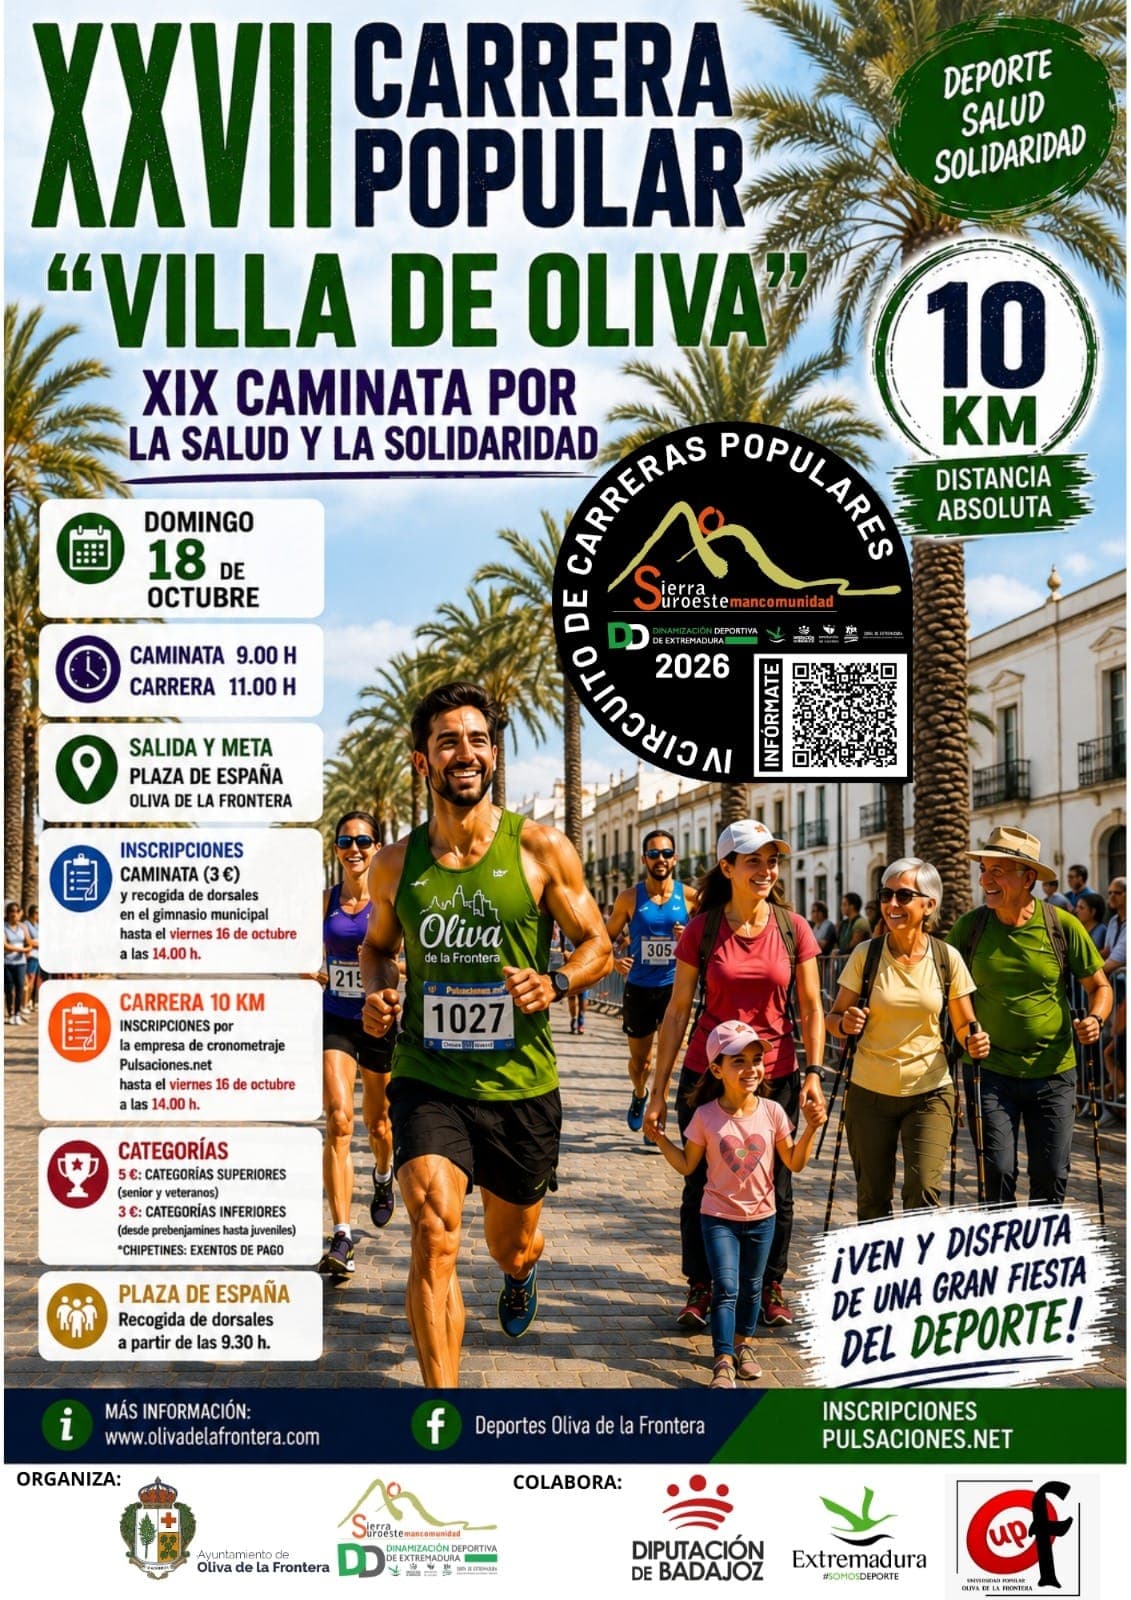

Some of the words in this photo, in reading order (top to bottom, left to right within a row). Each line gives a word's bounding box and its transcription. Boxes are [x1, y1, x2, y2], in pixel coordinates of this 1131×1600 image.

[354, 22, 733, 118] CARRERA
[943, 49, 1053, 100] DEPORTE
[961, 90, 1045, 137] SALUD
[31, 22, 332, 228] XXVII
[933, 124, 1086, 184] SOLIDARIDAD
[354, 128, 745, 228] POPULAR
[47, 252, 356, 348] “VILLA
[391, 253, 498, 347] DE
[528, 252, 808, 347] OLIVA”
[926, 280, 1045, 389] 10
[142, 369, 218, 417] XIX
[235, 368, 470, 416] CAMINATA
[489, 369, 577, 416] POR
[942, 395, 1037, 446] KM
[129, 427, 172, 462] LA
[182, 426, 290, 461] SALUD
[302, 426, 318, 461] Y
[334, 426, 375, 461] LA
[384, 425, 599, 461] SOLIDARIDAD
[936, 465, 1051, 492] DISTANCIA
[566, 435, 707, 576] CARRERAS
[720, 432, 894, 561] POPULARES
[936, 494, 1053, 521] ABSOLUTA
[145, 511, 254, 533] DOMINGO
[149, 538, 206, 580] 18
[220, 562, 245, 580] DE
[147, 587, 259, 608] OCTUBRE
[563, 589, 589, 634] DE
[653, 626, 712, 634] DINAMIZACIÓN
[714, 627, 758, 635] DEPORTIVA
[653, 637, 661, 645] DE
[665, 637, 724, 645] EXTREMADURA
[130, 646, 225, 665] CAMINATA
[236, 646, 278, 665] 9.00
[284, 646, 296, 665] H
[655, 654, 730, 678] 2026
[130, 677, 215, 696] CARRERA
[229, 677, 276, 696] 11.00
[283, 677, 296, 696] H
[761, 663, 781, 768] INFÓRMATE
[130, 738, 197, 757] SALIDA
[204, 738, 215, 757] Y
[222, 738, 273, 757] META
[130, 767, 184, 784] PLAZA
[190, 767, 210, 784] DE
[217, 763, 283, 784] ESPAÑA
[130, 794, 170, 808] OLIVA
[175, 794, 192, 808] DE
[197, 794, 214, 808] LA
[219, 794, 293, 808] FRONTERA
[120, 842, 244, 858] INSCRIPCIONES
[120, 867, 198, 882] CAMINATA
[120, 892, 127, 903] y
[132, 889, 184, 903] recogida
[189, 889, 203, 901] de
[207, 889, 259, 901] dorsales
[120, 911, 135, 920] en
[139, 908, 149, 920] el
[153, 908, 207, 923] gimnasio
[211, 908, 269, 923] municipal
[120, 928, 152, 940] hasta
[156, 928, 166, 940] el
[170, 928, 212, 940] viernes
[216, 928, 230, 940] 16
[234, 928, 248, 940] de
[252, 928, 297, 940] octubre
[419, 914, 502, 949] Oliva
[424, 952, 438, 963] de
[441, 952, 450, 963] la
[453, 952, 500, 963] Frontera
[648, 944, 672, 957] 305
[120, 993, 203, 1012] CARRERA
[211, 993, 231, 1012] 10
[236, 993, 265, 1012] KM
[120, 1020, 210, 1032] INSCRIPCIONES
[214, 1022, 234, 1034] por
[432, 1003, 505, 1033] 1027
[120, 1039, 130, 1051] la
[134, 1042, 184, 1054] empresa
[189, 1039, 203, 1051] de
[207, 1039, 285, 1054] cronometraje
[120, 1059, 212, 1071] Pulsaciones.net
[118, 1137, 229, 1160] CATEGORÍAS
[145, 1166, 214, 1180] CATEGORÍAS
[217, 1169, 286, 1180] SUPERIORES
[145, 1203, 216, 1218] CATEGORÍAS
[220, 1206, 286, 1218] INFERIORES
[117, 1225, 149, 1236] (desde
[152, 1225, 220, 1236] prebenjamines
[223, 1225, 248, 1236] hasta
[251, 1225, 296, 1237] juveniles)
[190, 1245, 237, 1255] EXENTOS
[240, 1245, 253, 1255] DE
[257, 1245, 284, 1255] PAGO
[831, 1237, 904, 1284] ¡VEN
[917, 1232, 935, 1265] Y
[946, 1213, 1071, 1260] DISFRUTA
[119, 1284, 180, 1303] PLAZA
[187, 1284, 210, 1303] DE
[216, 1280, 290, 1303] ESPAÑA
[831, 1287, 865, 1321] DE
[873, 1277, 922, 1313] UNA
[932, 1266, 999, 1303] GRAN
[1007, 1255, 1086, 1294] FIESTA
[119, 1312, 185, 1329] Recogida
[190, 1312, 207, 1326] de
[211, 1312, 273, 1326] dorsales
[840, 1324, 896, 1368] DEL
[910, 1296, 1083, 1359] DEPORTE!
[118, 1339, 127, 1349] a
[131, 1335, 171, 1352] partir
[175, 1335, 193, 1349] de
[197, 1335, 217, 1349] las
[221, 1335, 253, 1349] 9.30
[257, 1335, 270, 1349] h.
[105, 1400, 138, 1420] MÁS
[143, 1400, 251, 1420] INFORMACIÓN:
[823, 1401, 977, 1421] INSCRIPCIONES
[105, 1426, 320, 1446] www.olivadelafrontera.com
[475, 1415, 547, 1438] Deportes
[551, 1415, 591, 1435] Oliva
[596, 1415, 615, 1435] de
[620, 1415, 634, 1435] la
[640, 1415, 705, 1435] Frontera
[822, 1429, 1013, 1449] PULSACIONES.NET
[16, 1471, 121, 1487] ORGANIZA:
[513, 1474, 622, 1490] COLABORA:
[198, 1550, 272, 1561] Ayuntamiento
[275, 1550, 289, 1559] de
[632, 1534, 764, 1560] DIPUTACIÓN
[197, 1562, 232, 1573] Oliva
[235, 1562, 253, 1573] de
[257, 1562, 269, 1573] la
[273, 1562, 330, 1573] Frontera
[793, 1549, 926, 1568] Extremadura
[632, 1566, 652, 1581] DE
[659, 1561, 764, 1581] BADAJOZ
